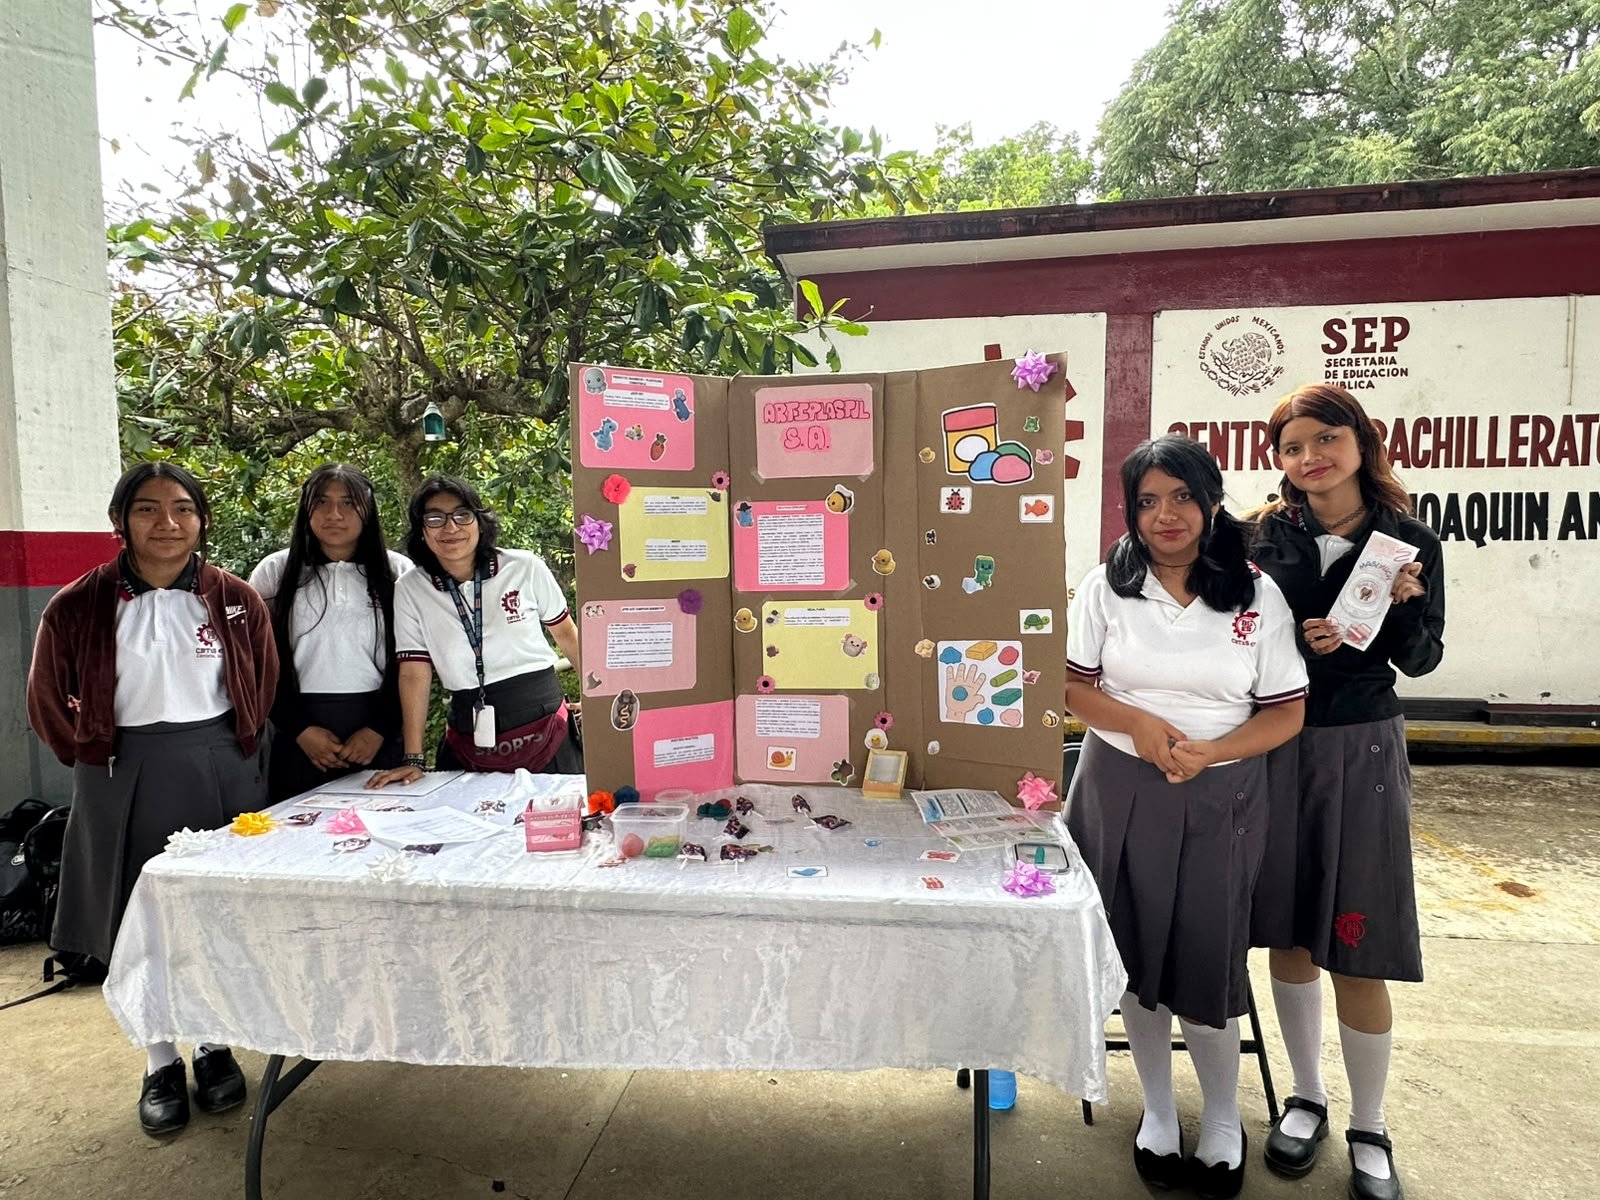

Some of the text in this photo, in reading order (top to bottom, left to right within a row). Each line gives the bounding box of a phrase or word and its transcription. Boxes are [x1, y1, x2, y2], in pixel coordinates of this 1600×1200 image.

[1199, 315, 1285, 360] ESTADOS UNIDOS MEXICANOS
[1321, 316, 1410, 355] SEP
[1325, 356, 1397, 368] SECRETARIA
[1325, 368, 1408, 379] DE EDUCACION
[225, 605, 243, 615] NIKE
